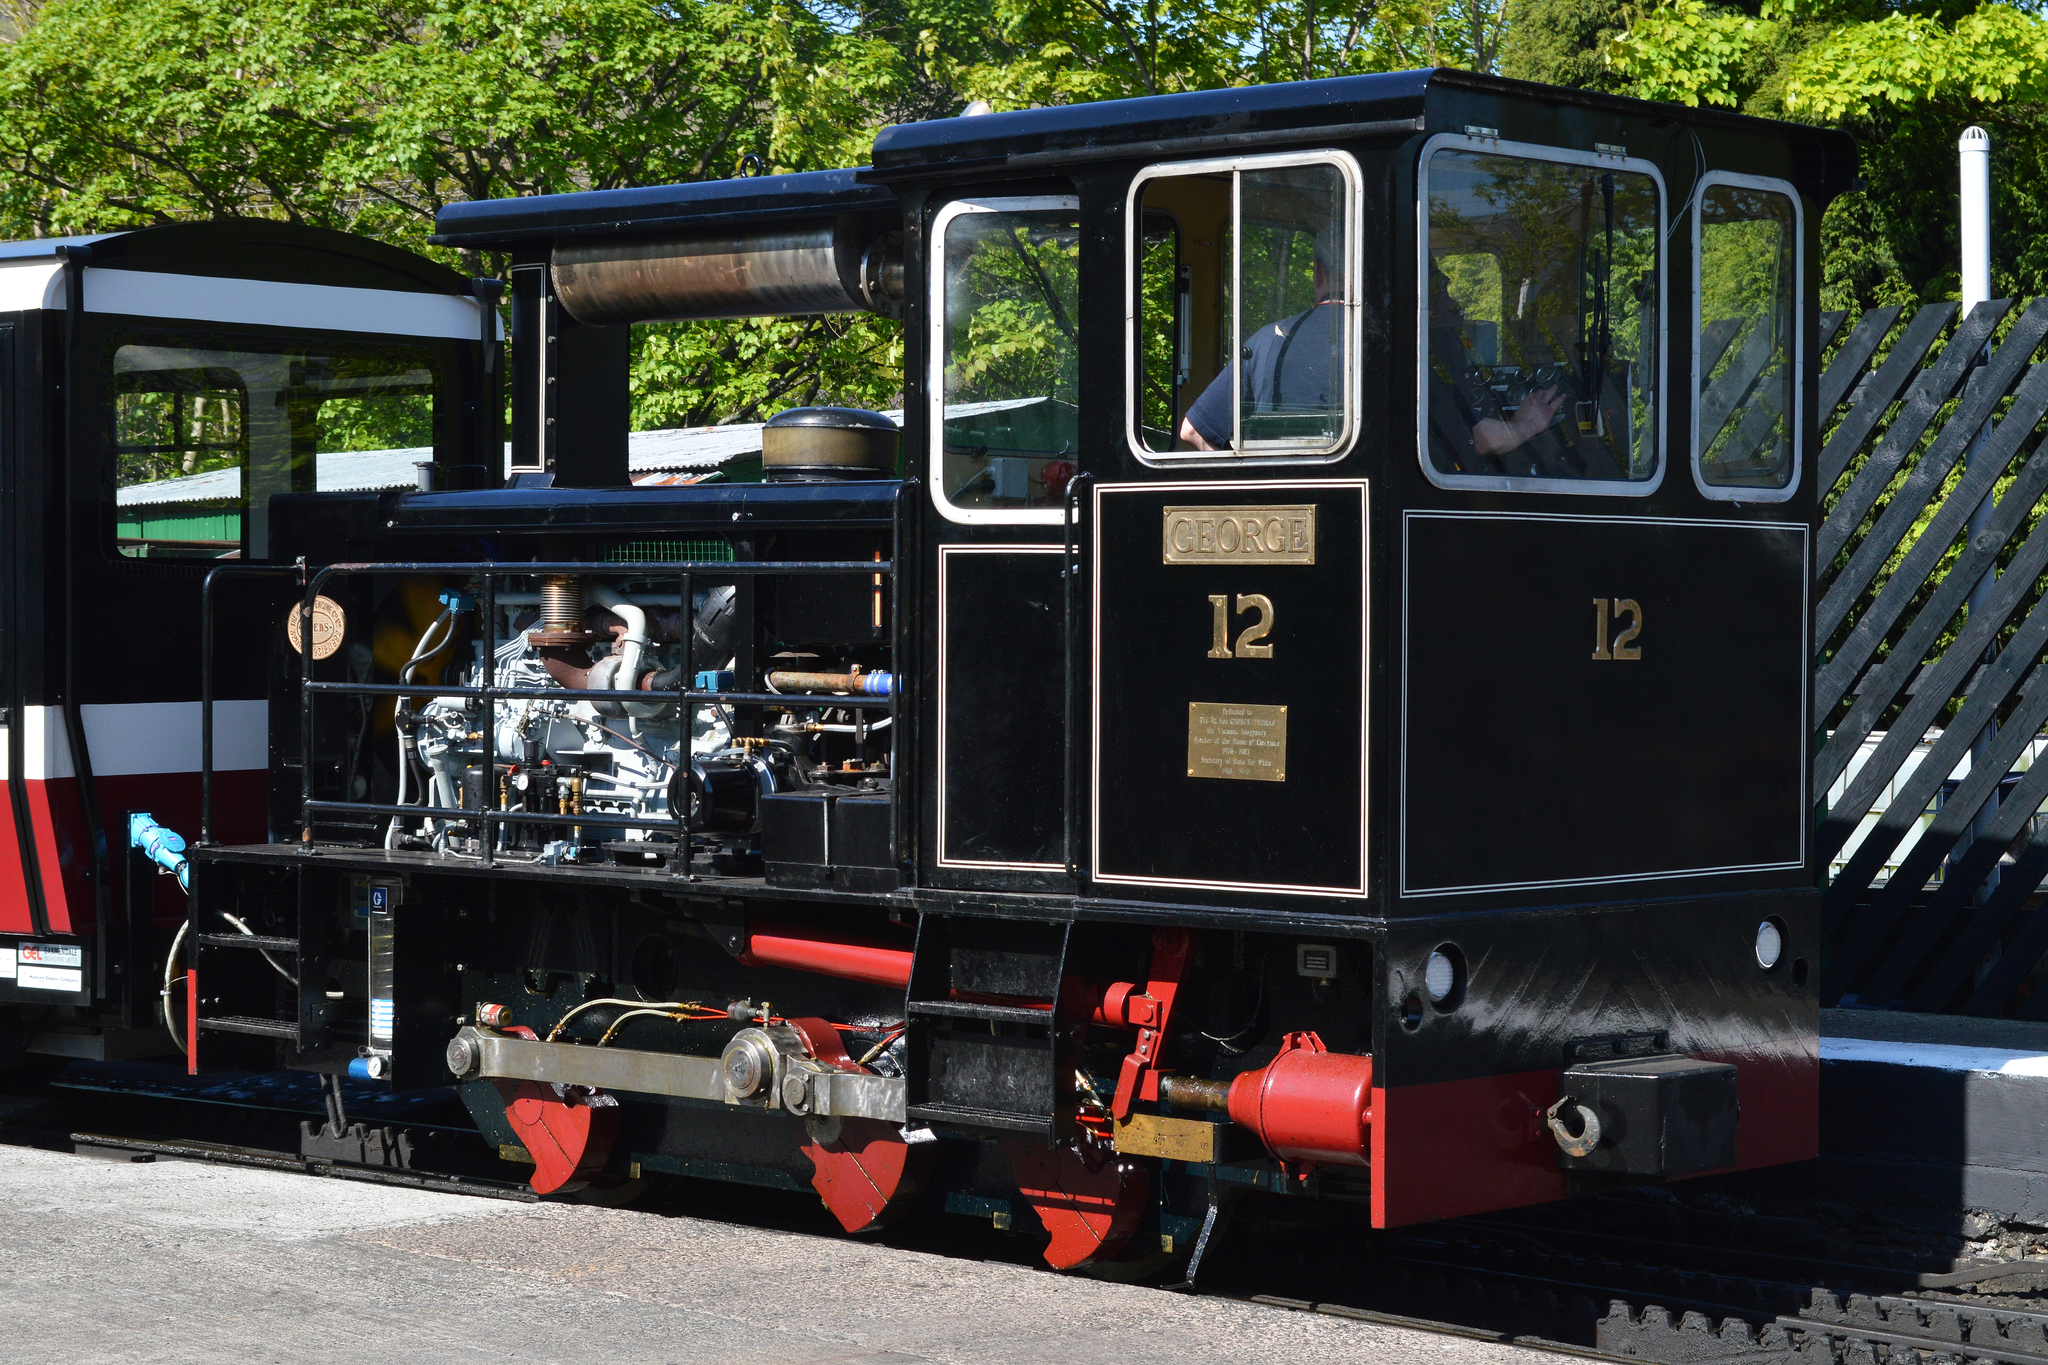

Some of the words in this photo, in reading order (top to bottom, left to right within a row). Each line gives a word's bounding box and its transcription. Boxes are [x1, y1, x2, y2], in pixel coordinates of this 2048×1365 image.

[1170, 516, 1309, 554] GEORGE
[1207, 592, 1274, 659] 12
[1591, 597, 1642, 661] 12
[22, 945, 43, 961] GEL
[44, 946, 77, 957] GARMENDALE
